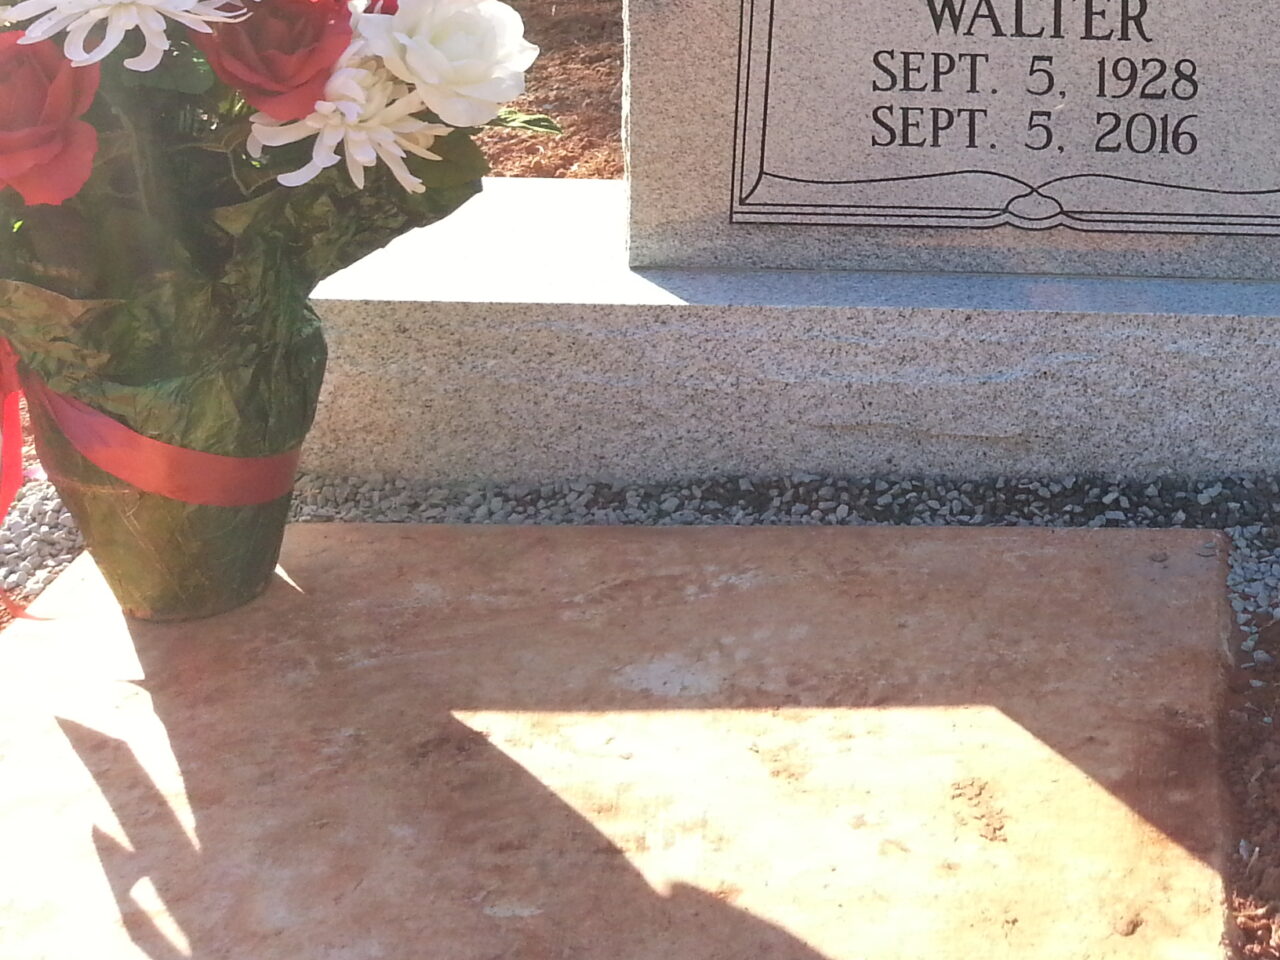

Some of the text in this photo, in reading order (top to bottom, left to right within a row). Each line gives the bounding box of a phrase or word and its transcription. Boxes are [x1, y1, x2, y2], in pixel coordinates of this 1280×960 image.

[872, 49, 1199, 101] SEPT. 5, 1928
[871, 104, 1199, 155] SEPT. 5, 2016
